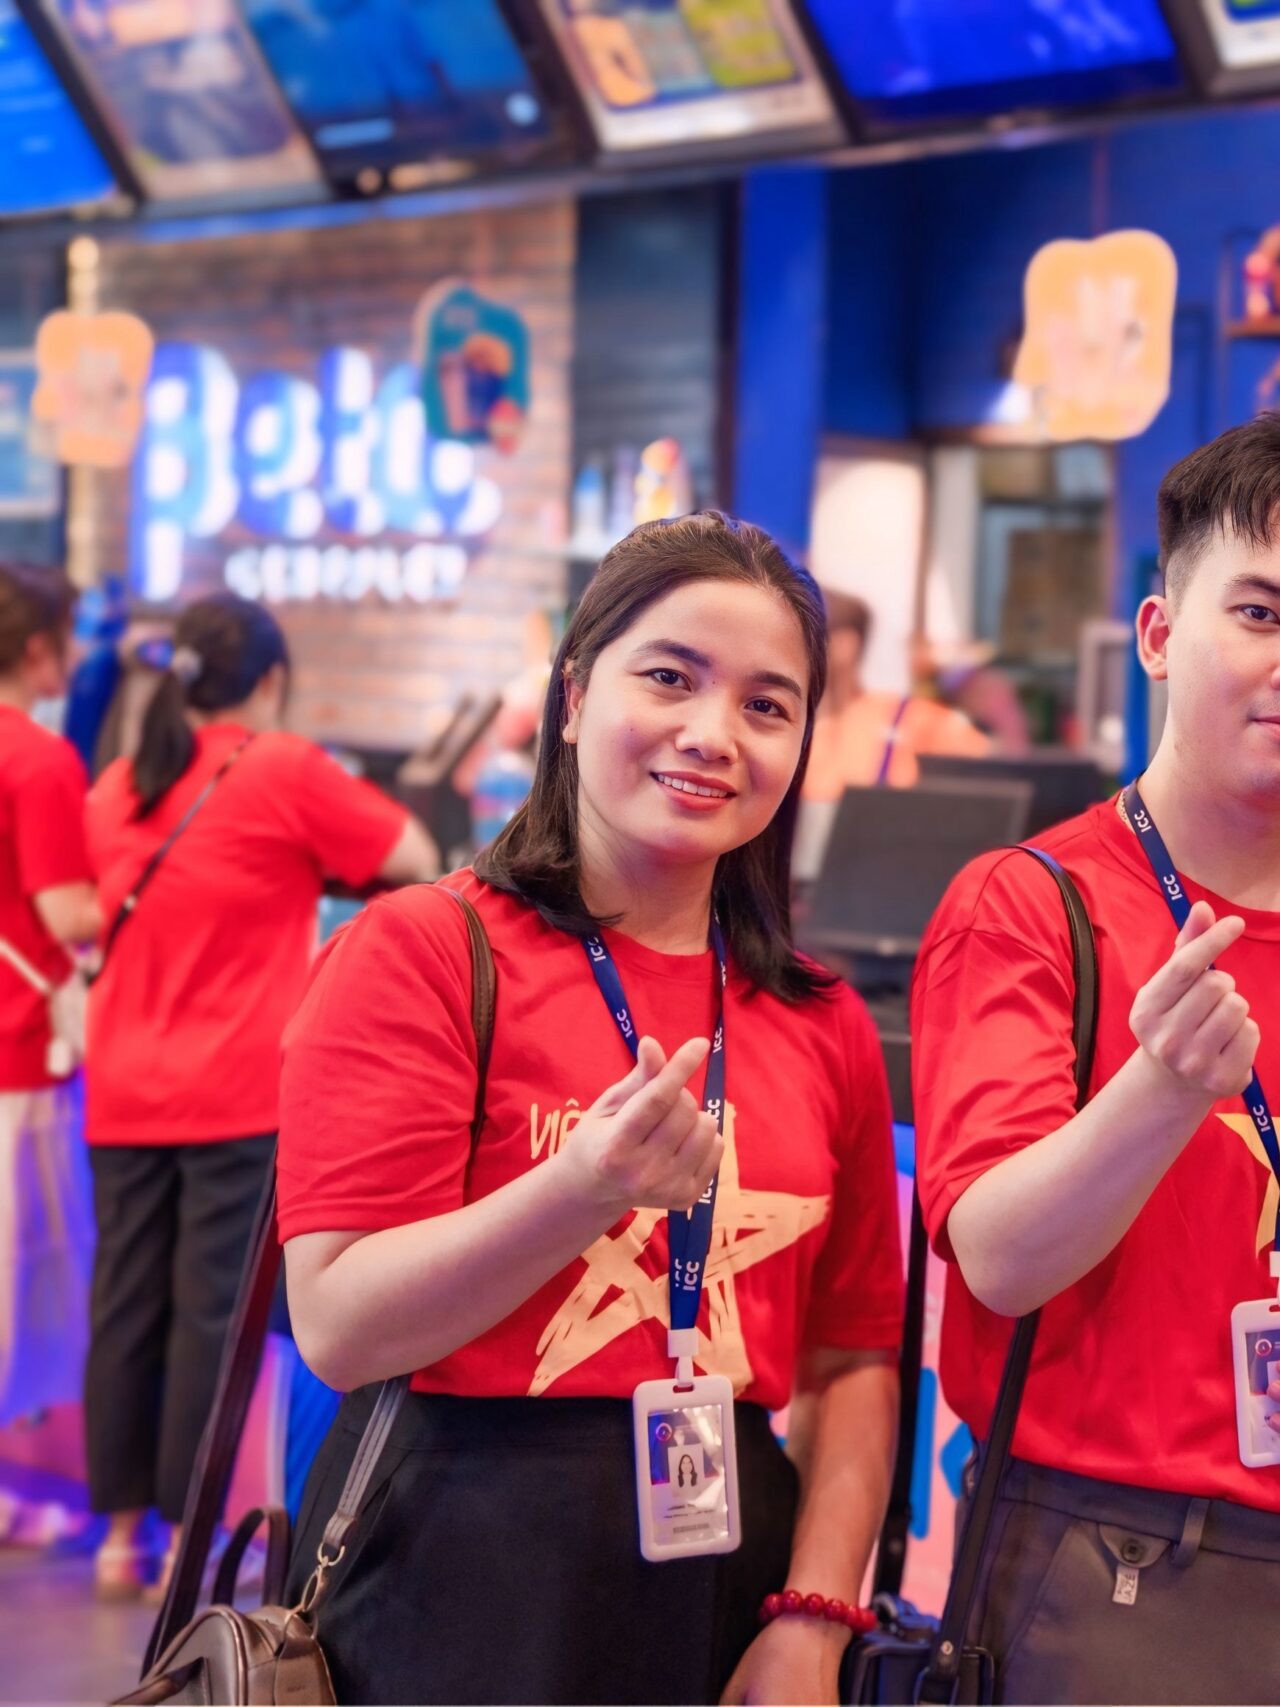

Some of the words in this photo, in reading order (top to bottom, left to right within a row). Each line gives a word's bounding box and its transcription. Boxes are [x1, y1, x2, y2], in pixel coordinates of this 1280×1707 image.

[1134, 809, 1151, 833] ICC
[1163, 874, 1183, 901] ICC
[616, 1008, 632, 1038] ICC
[710, 1026, 722, 1054] ICC
[1253, 1104, 1271, 1132] ICC
[682, 1260, 699, 1291] ICC
